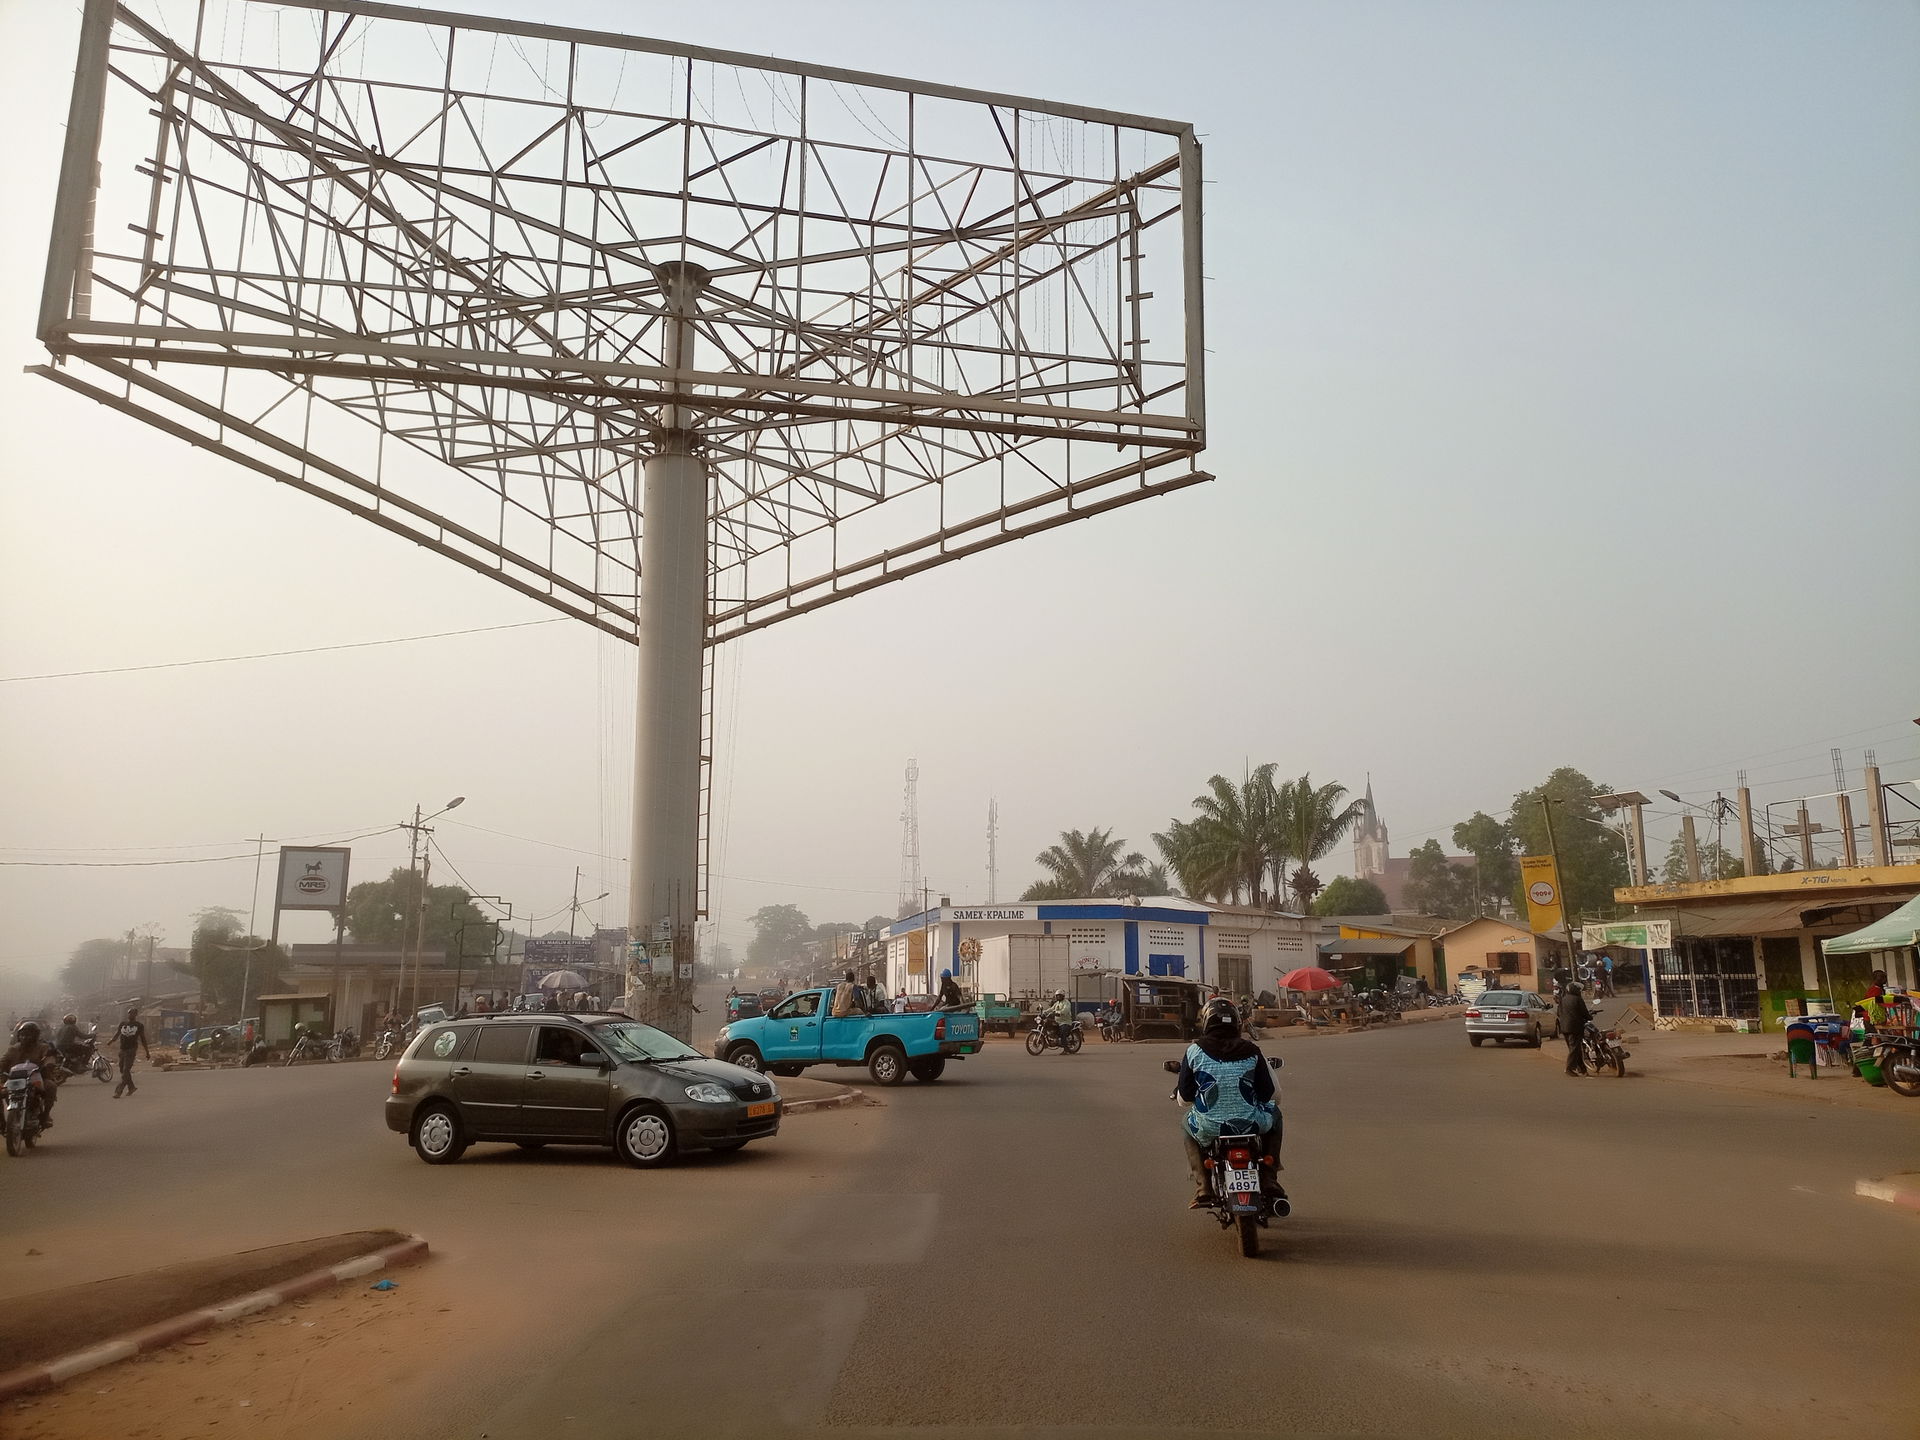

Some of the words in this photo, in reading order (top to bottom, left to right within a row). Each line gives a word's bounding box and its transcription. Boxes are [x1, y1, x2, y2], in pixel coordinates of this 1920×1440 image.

[299, 881, 326, 889] MRS
[1801, 875, 1830, 885] X-TIGI
[953, 910, 1025, 920] SAMEX-KPALIME
[951, 1024, 975, 1035] TOYOTA
[1234, 1170, 1250, 1181] DE
[1228, 1181, 1257, 1191] 4897
